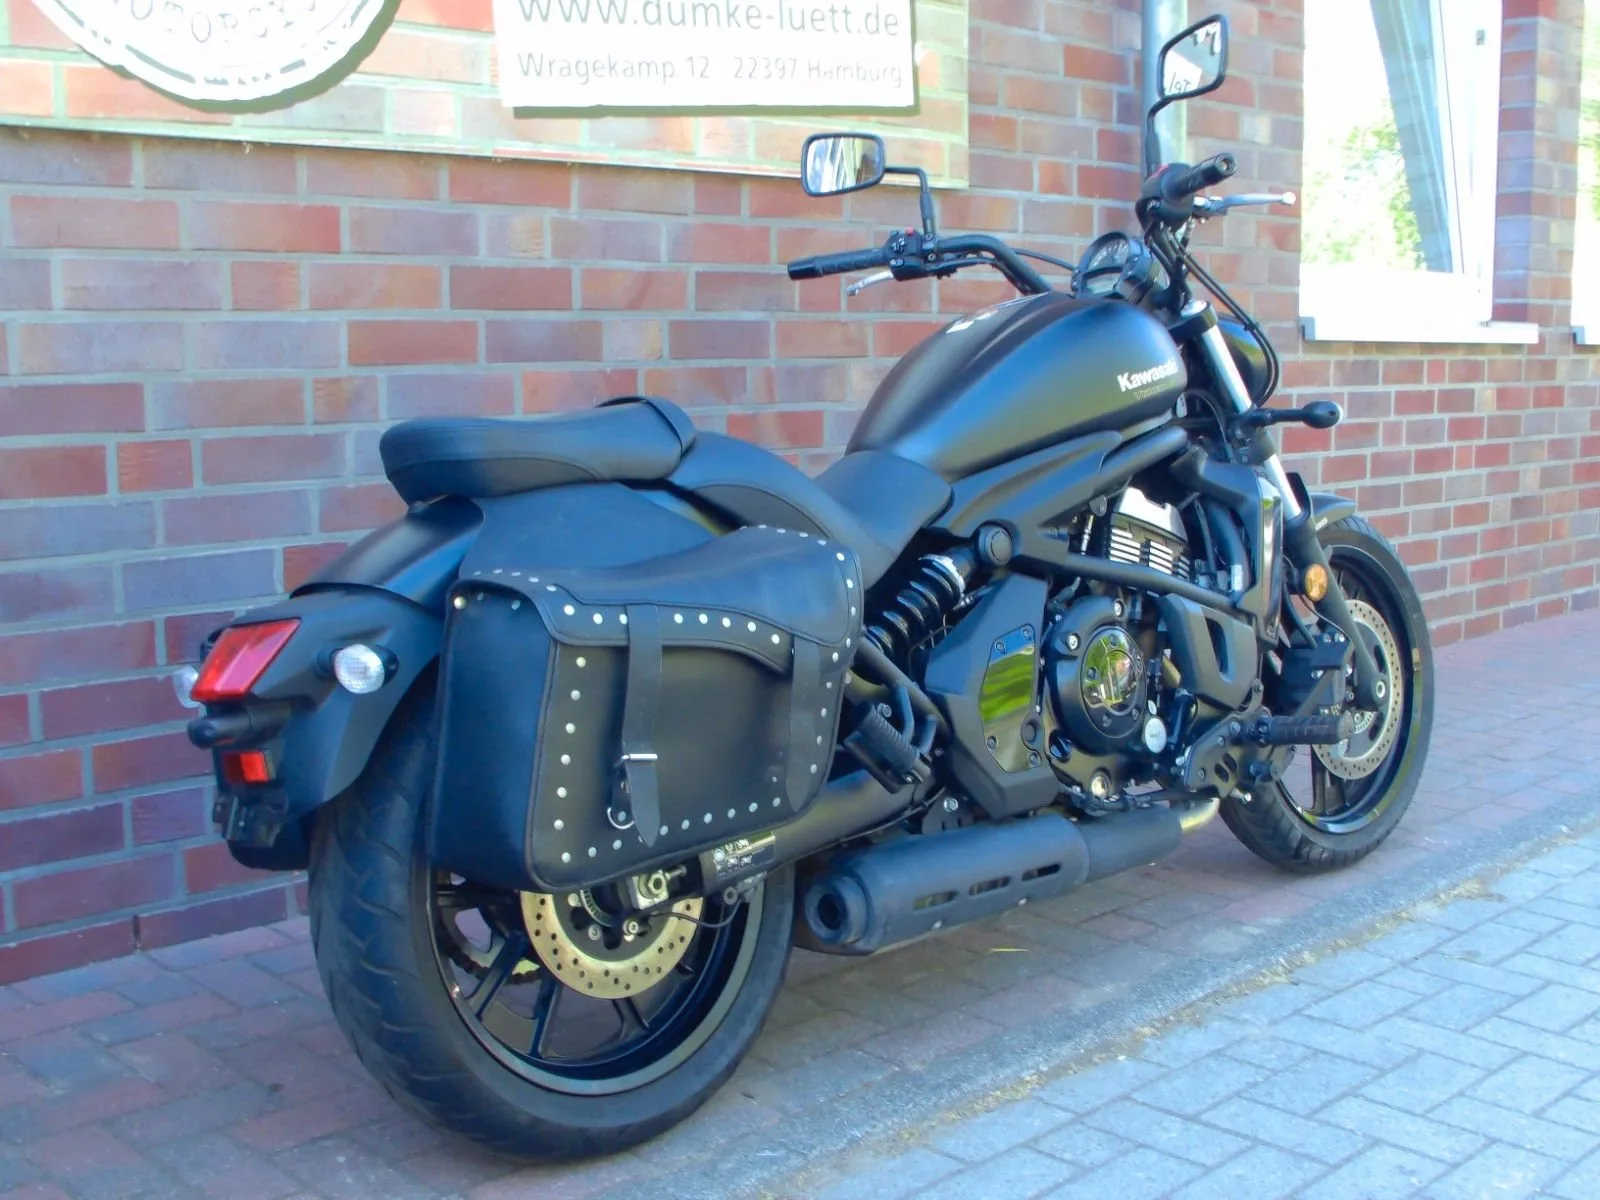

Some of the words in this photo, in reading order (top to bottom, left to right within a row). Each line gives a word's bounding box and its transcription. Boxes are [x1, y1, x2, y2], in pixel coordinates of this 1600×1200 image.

[518, 0, 899, 36] www.dumke-luett.de
[517, 52, 676, 84] Wragekamp
[687, 55, 710, 79] 12
[733, 56, 797, 80] 22397
[807, 60, 904, 88] Hamburg
